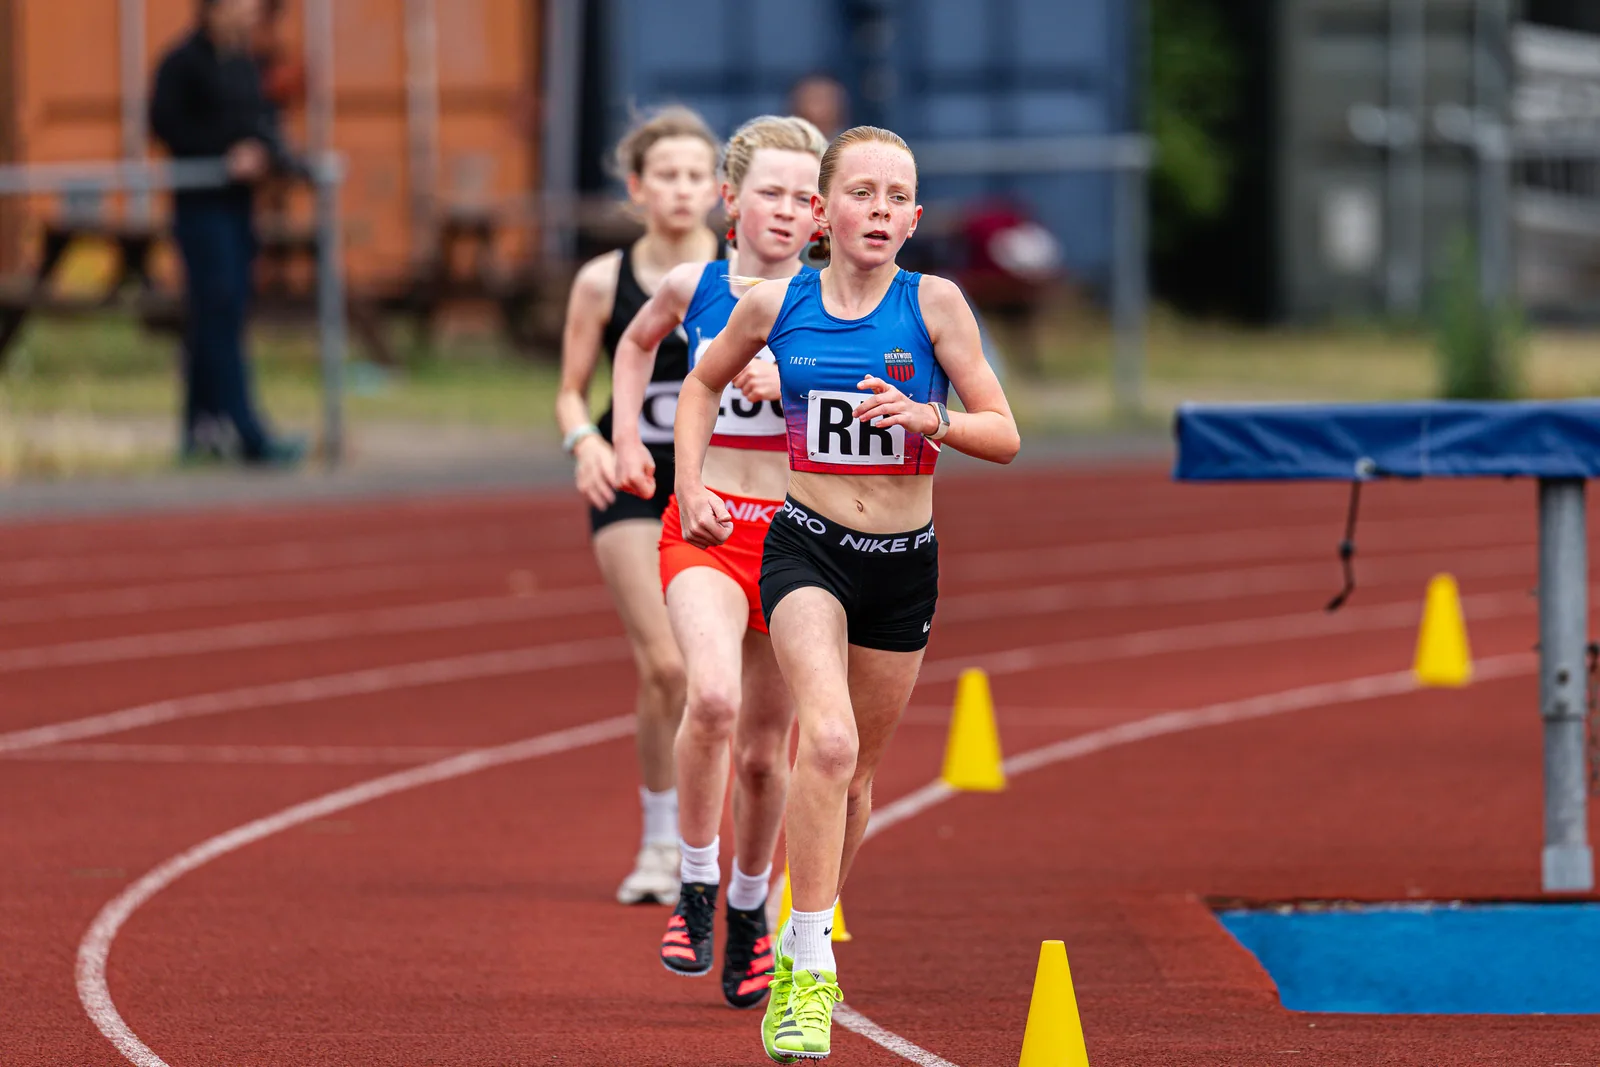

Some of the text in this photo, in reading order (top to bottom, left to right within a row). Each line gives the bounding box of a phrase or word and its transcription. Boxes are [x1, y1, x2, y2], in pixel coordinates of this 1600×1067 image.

[790, 356, 817, 366] TACTIC
[818, 398, 894, 456] RR
[725, 499, 785, 524] NIK
[783, 500, 935, 553] PRO NIKE PR
